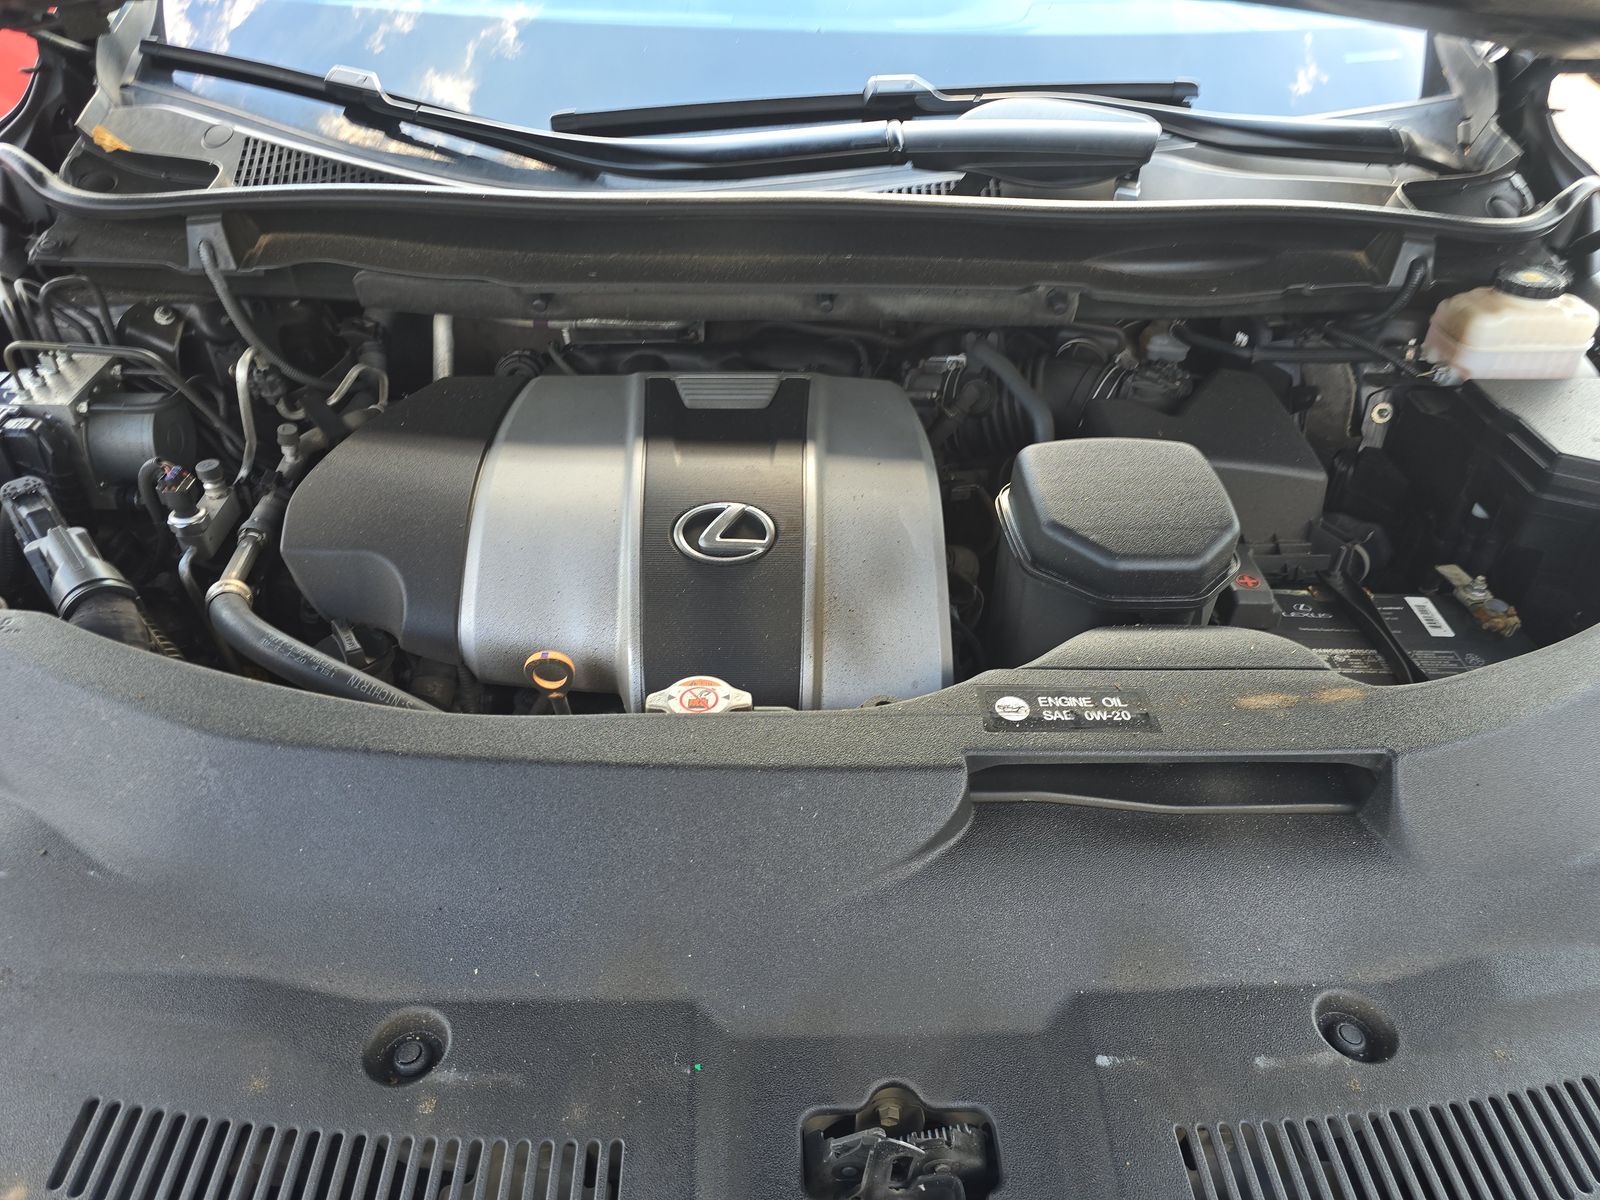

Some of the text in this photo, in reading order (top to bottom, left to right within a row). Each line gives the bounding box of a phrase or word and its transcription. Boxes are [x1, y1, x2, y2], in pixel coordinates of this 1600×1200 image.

[1037, 696, 1129, 708] ENGINE OIL
[1042, 710, 1132, 721] SAE 0W-20
